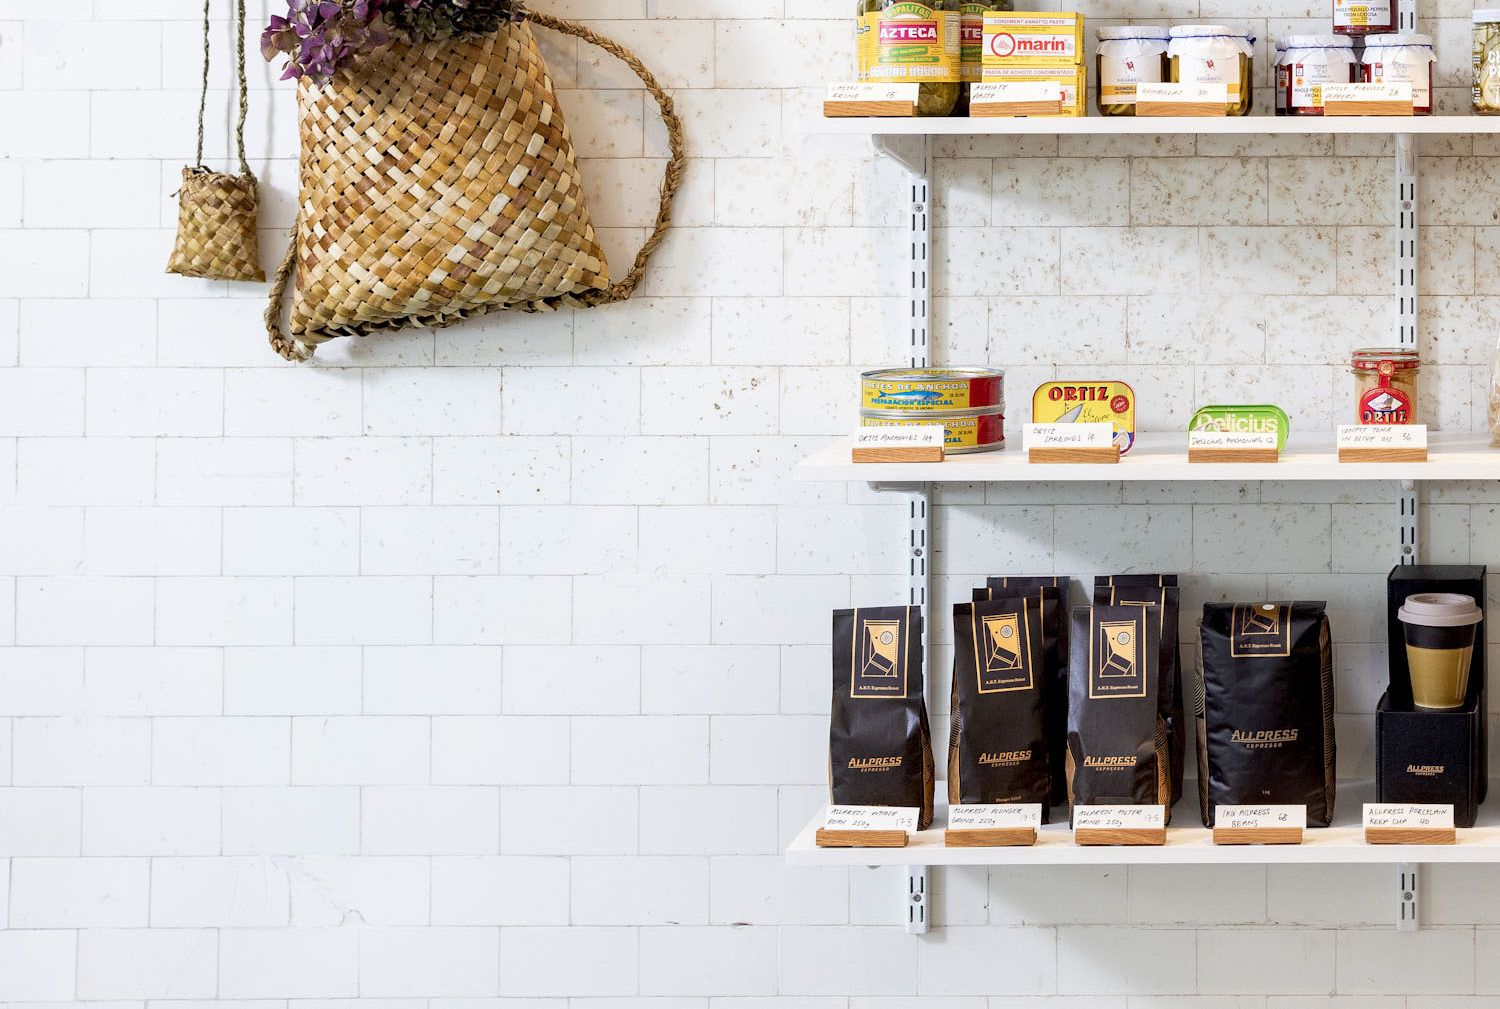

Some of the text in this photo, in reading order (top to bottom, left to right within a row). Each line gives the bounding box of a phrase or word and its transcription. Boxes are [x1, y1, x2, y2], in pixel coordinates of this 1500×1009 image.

[879, 27, 938, 39] AZTECA
[898, 382, 969, 391] DE ANCHOA
[1048, 385, 1109, 402] ORTIZ
[871, 399, 954, 407] PREPARACION ESPECIAL
[1363, 409, 1407, 423] ORTIZ
[858, 434, 880, 442] ORTIZ
[1044, 435, 1082, 444] SARDINES
[1266, 437, 1275, 445] 12
[1231, 729, 1298, 742] ALLPRESS
[848, 757, 902, 768] ALLPRESS
[978, 750, 1032, 765] ALLPRESS
[1083, 755, 1137, 767] ALLPRESS
[1406, 764, 1444, 773] ALLPRESS
[1238, 807, 1270, 817] ALLPRESS
[1368, 807, 1448, 816] ALLPRESS PORCELAIN
[852, 819, 870, 829] 250g
[978, 817, 996, 826] 250g
[1106, 819, 1122, 827] 250g
[1232, 813, 1288, 827] BEANS 68
